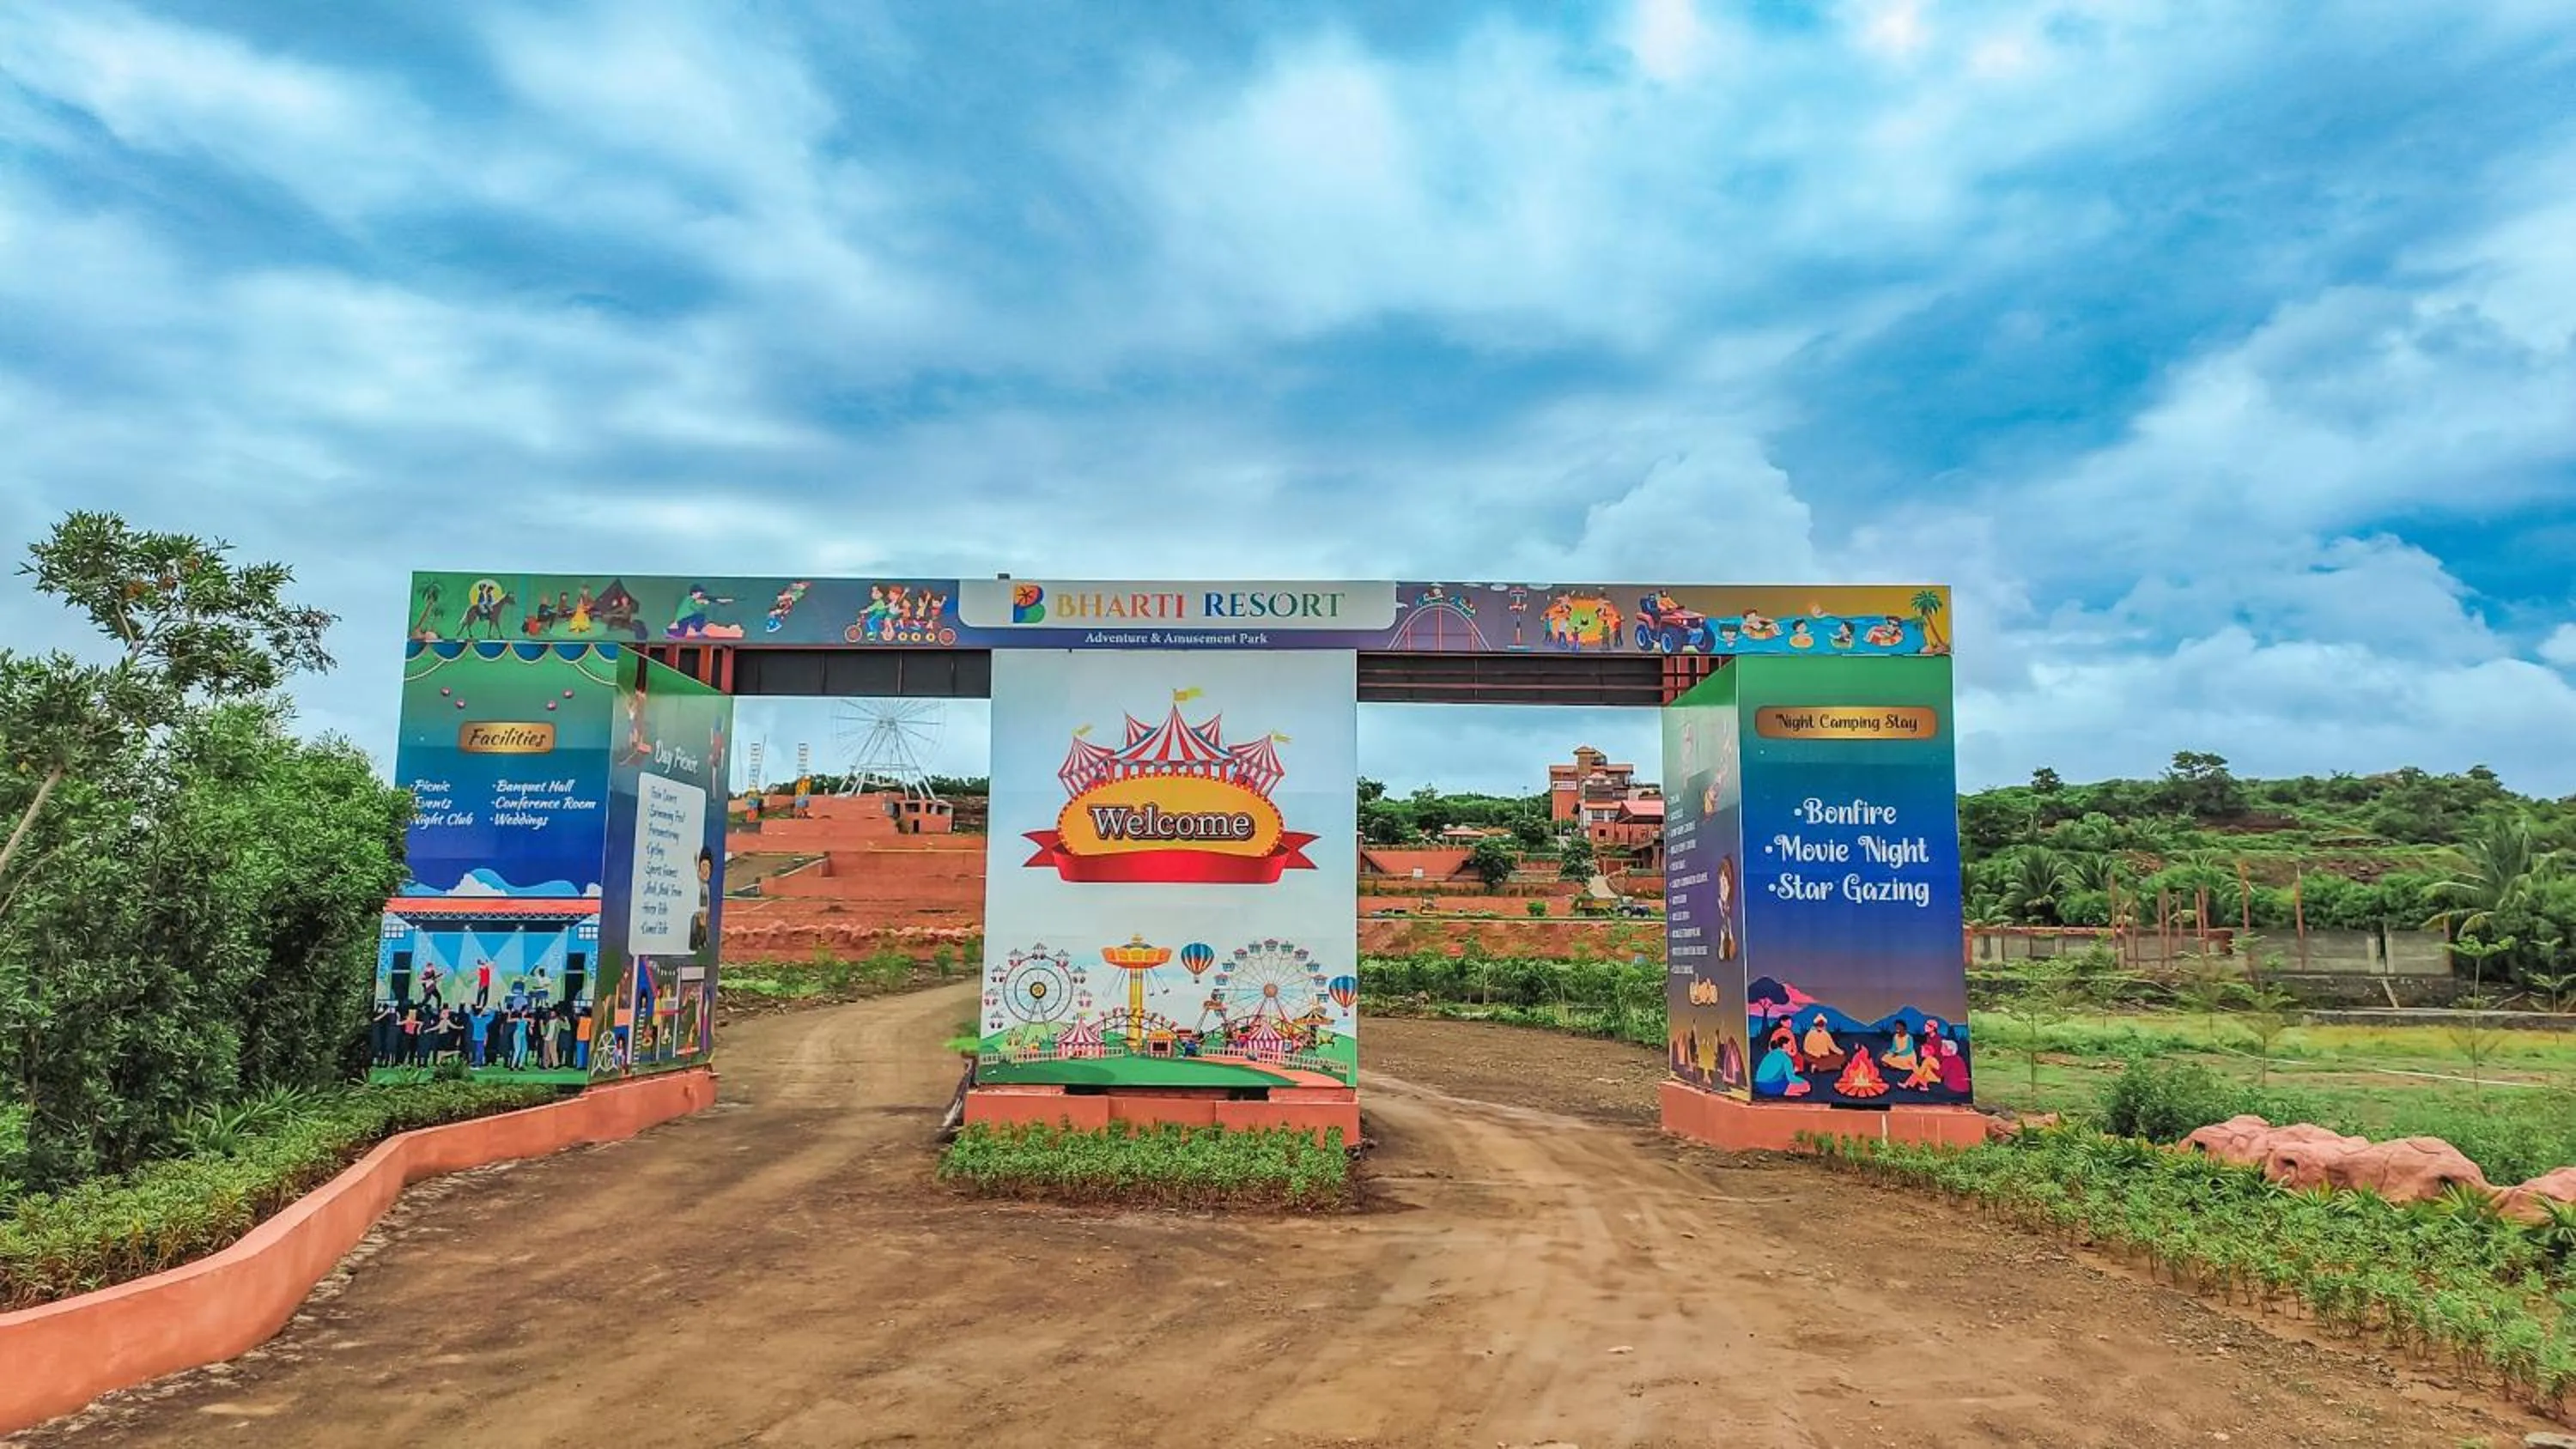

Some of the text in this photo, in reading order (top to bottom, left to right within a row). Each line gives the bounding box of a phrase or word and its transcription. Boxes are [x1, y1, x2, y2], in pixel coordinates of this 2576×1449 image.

[1056, 592, 1184, 619] BHARTI
[1204, 591, 1345, 619] RESORT
[1085, 632, 1268, 645] Adventure & Amusement Park
[1775, 714, 1918, 731] Night Camping Stay
[468, 728, 547, 747] Facilities
[413, 779, 451, 794] Picnic
[495, 779, 575, 796] Banquet Hall
[415, 796, 453, 809] Events
[495, 797, 597, 811] Conference Room
[1803, 797, 1897, 825] Bonfire
[447, 811, 474, 826] Club
[494, 814, 549, 829] Weddings
[1089, 803, 1255, 840] Welcome
[1774, 834, 1929, 869] Movie Night
[1777, 872, 1929, 907] Star Gazing
